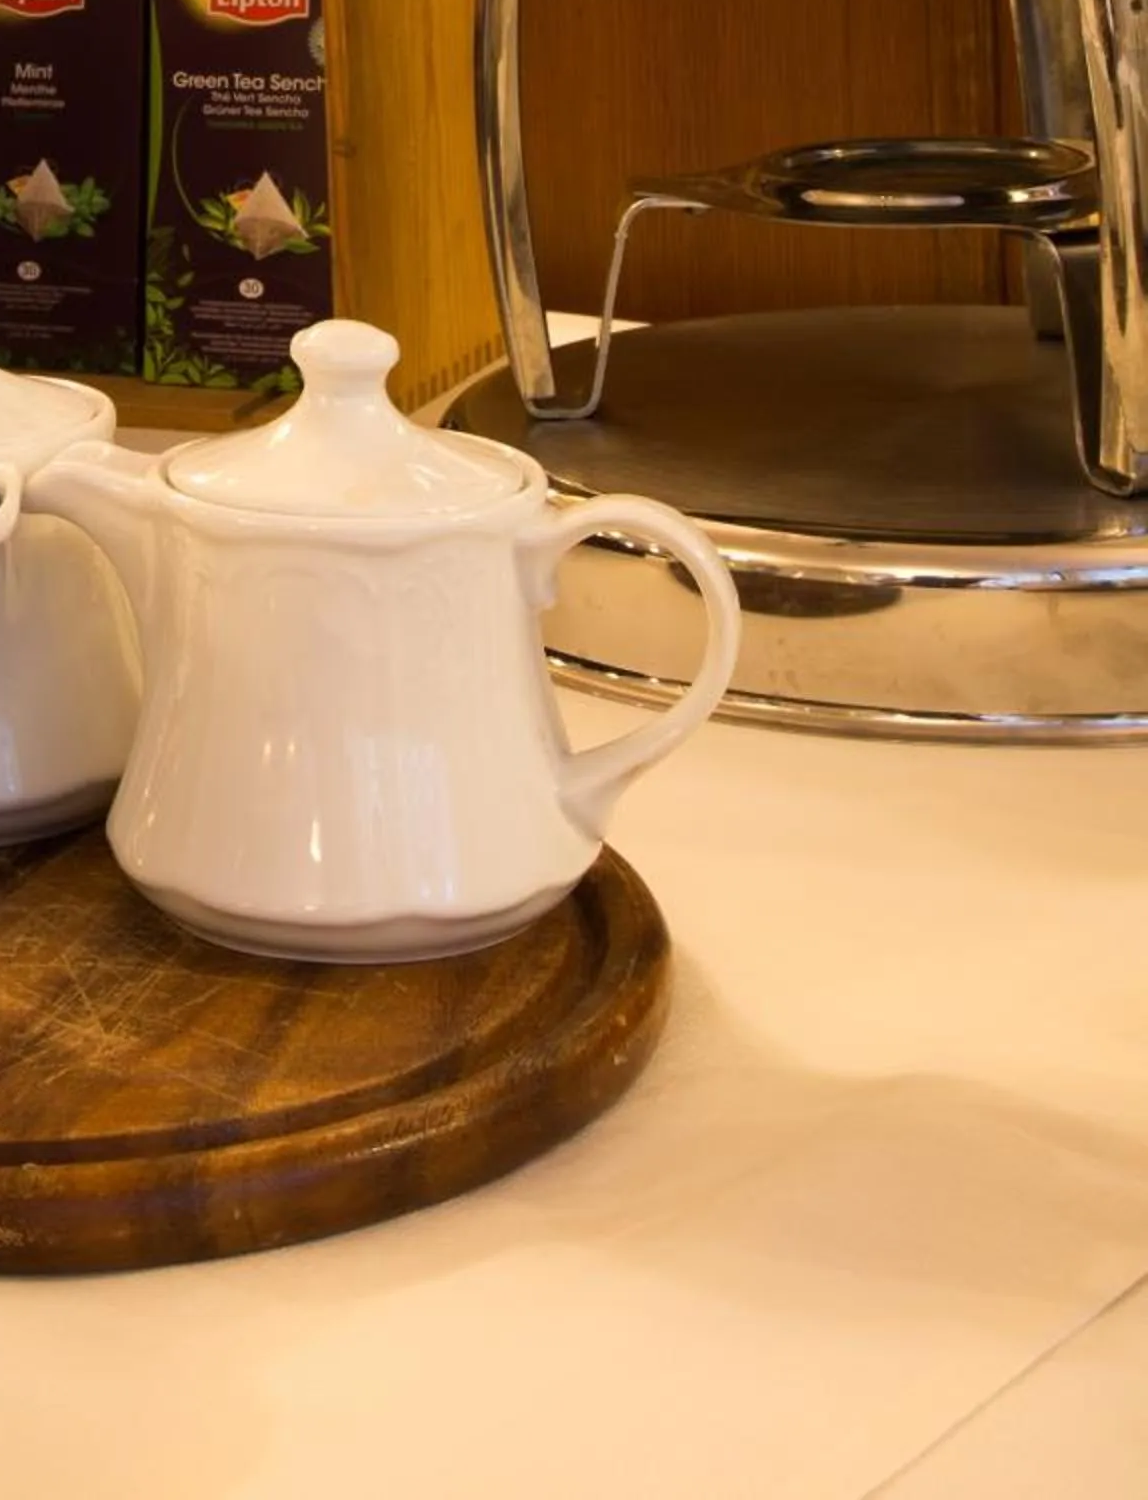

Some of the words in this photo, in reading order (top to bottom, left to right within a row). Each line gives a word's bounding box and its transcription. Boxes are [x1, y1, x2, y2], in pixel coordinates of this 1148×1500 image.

[14, 63, 54, 80] Mint
[173, 71, 229, 89] Green
[233, 73, 265, 90] Tea
[270, 74, 327, 91] Sench
